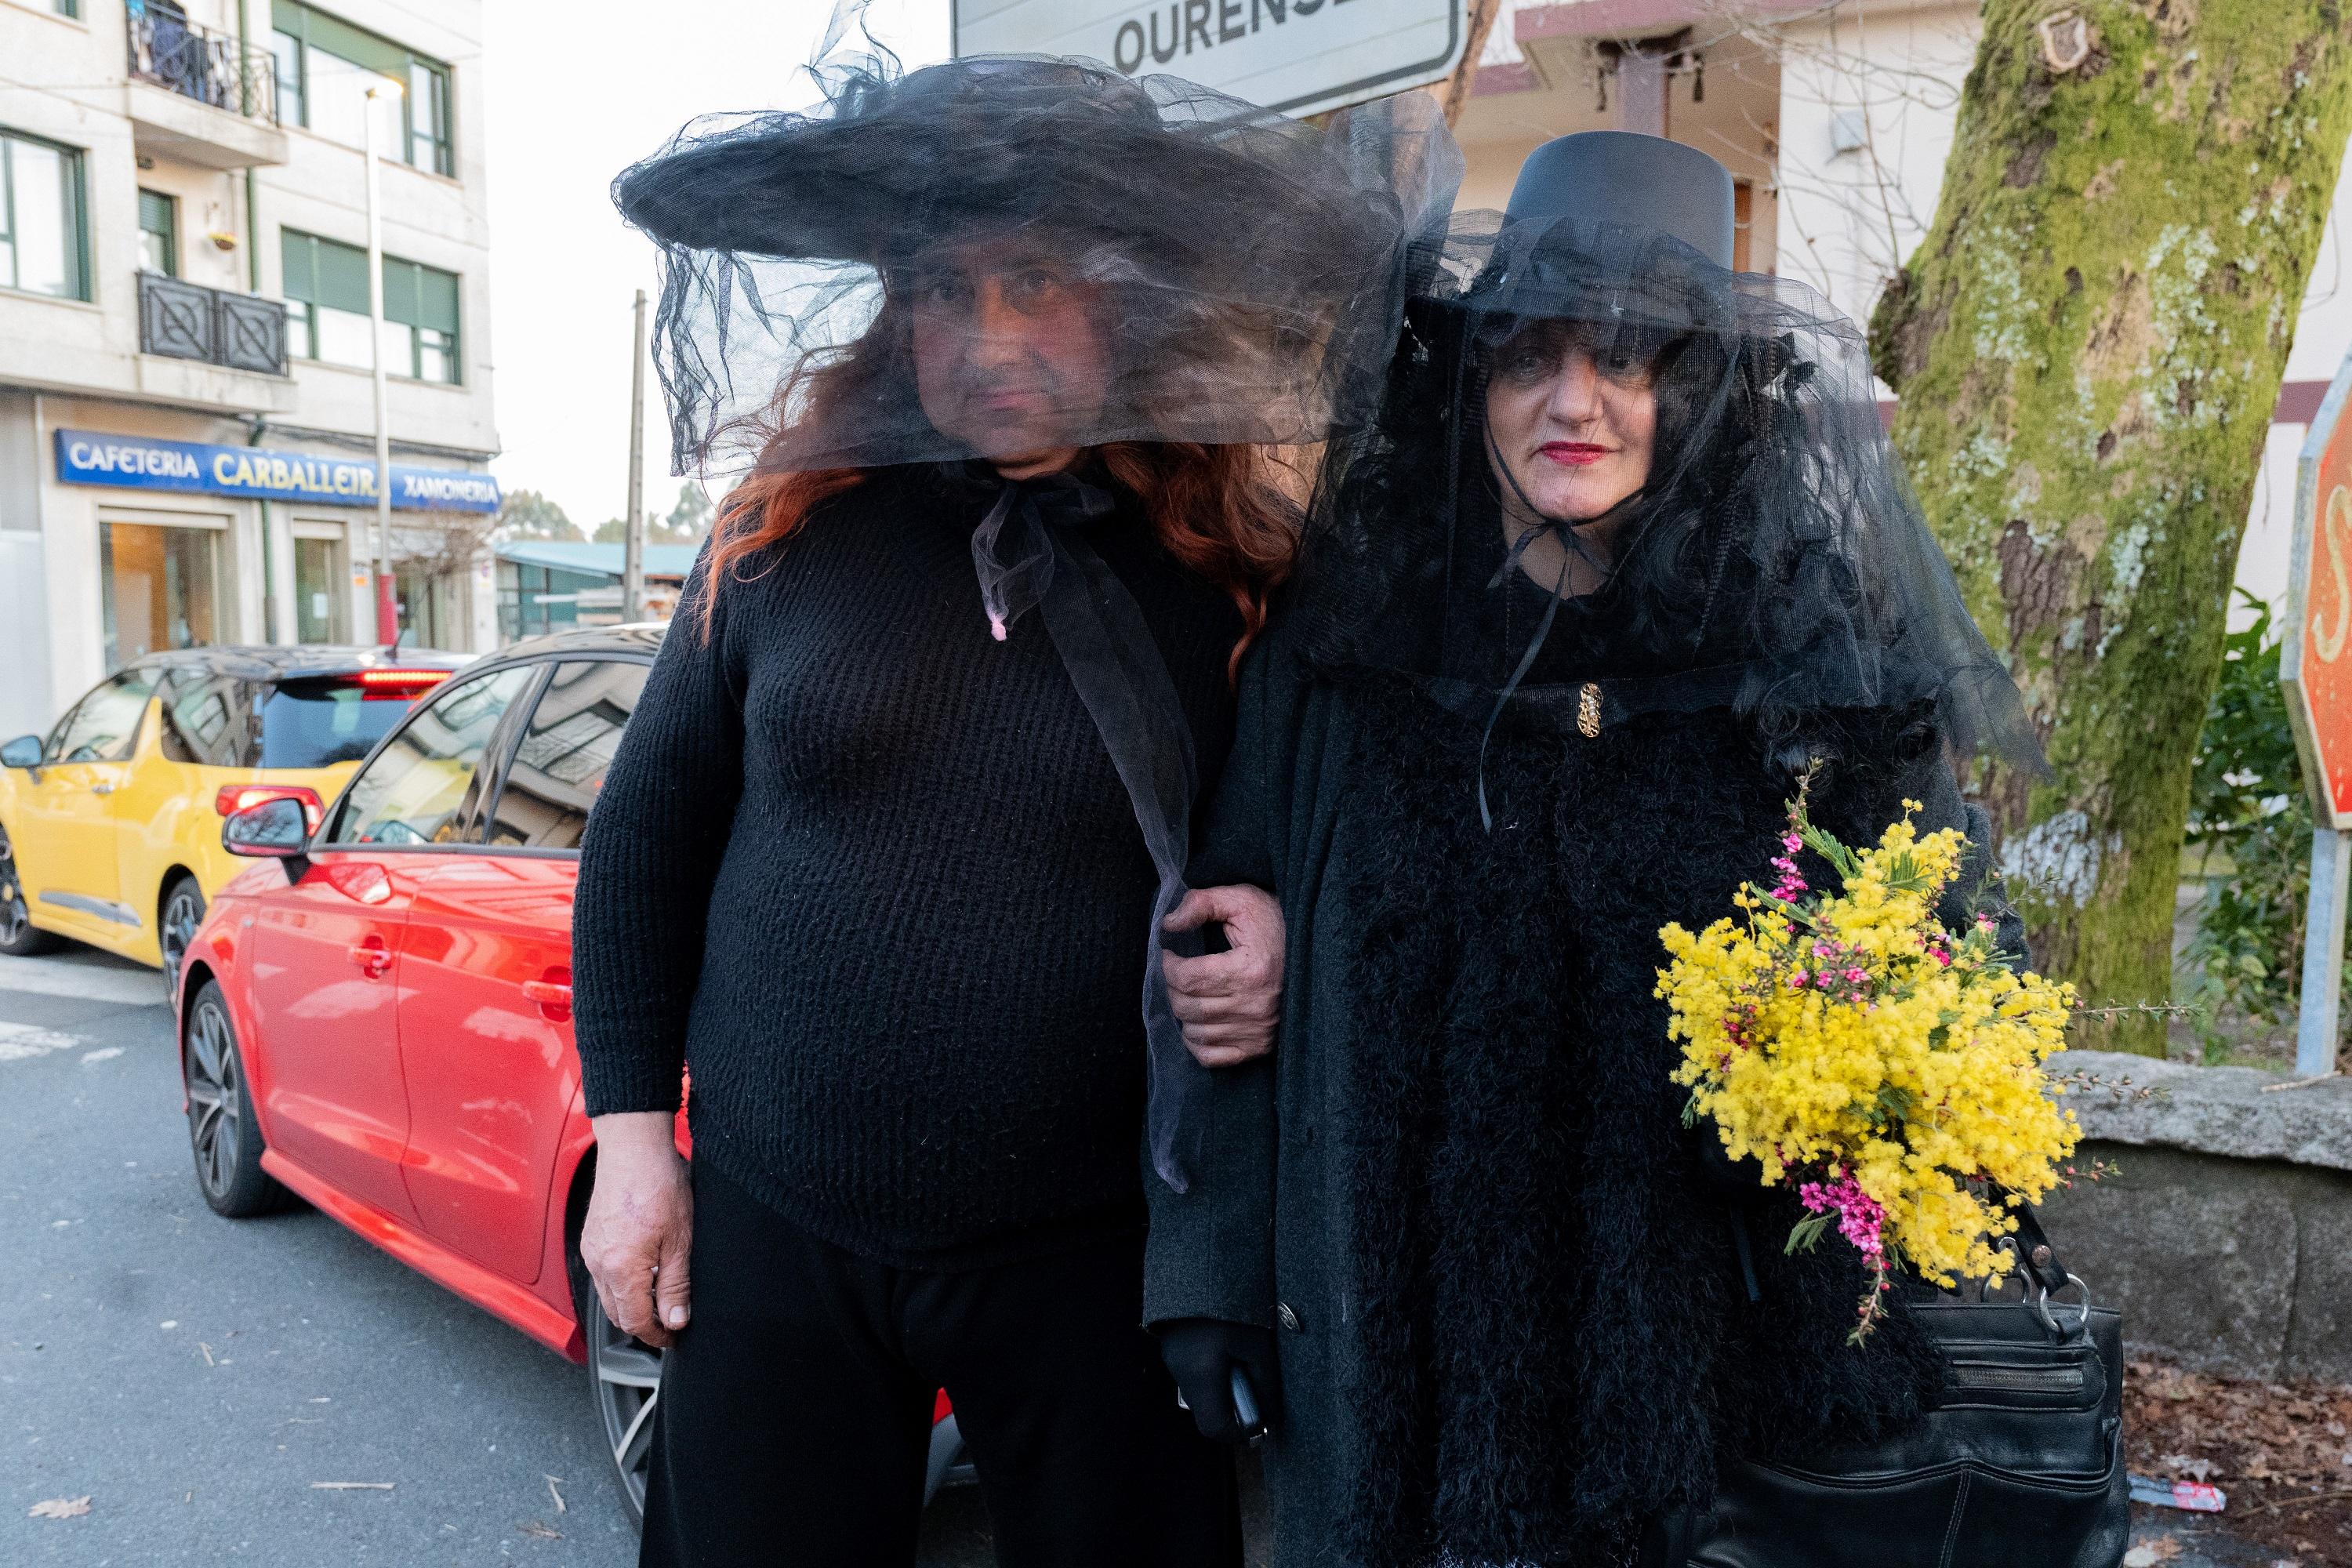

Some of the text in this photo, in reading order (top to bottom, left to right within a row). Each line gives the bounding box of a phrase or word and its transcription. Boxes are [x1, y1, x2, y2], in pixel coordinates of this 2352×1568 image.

[1114, 0, 1348, 74] OUREN
[69, 442, 200, 478] CAFETERIA
[213, 453, 390, 497] CARBALLEIR
